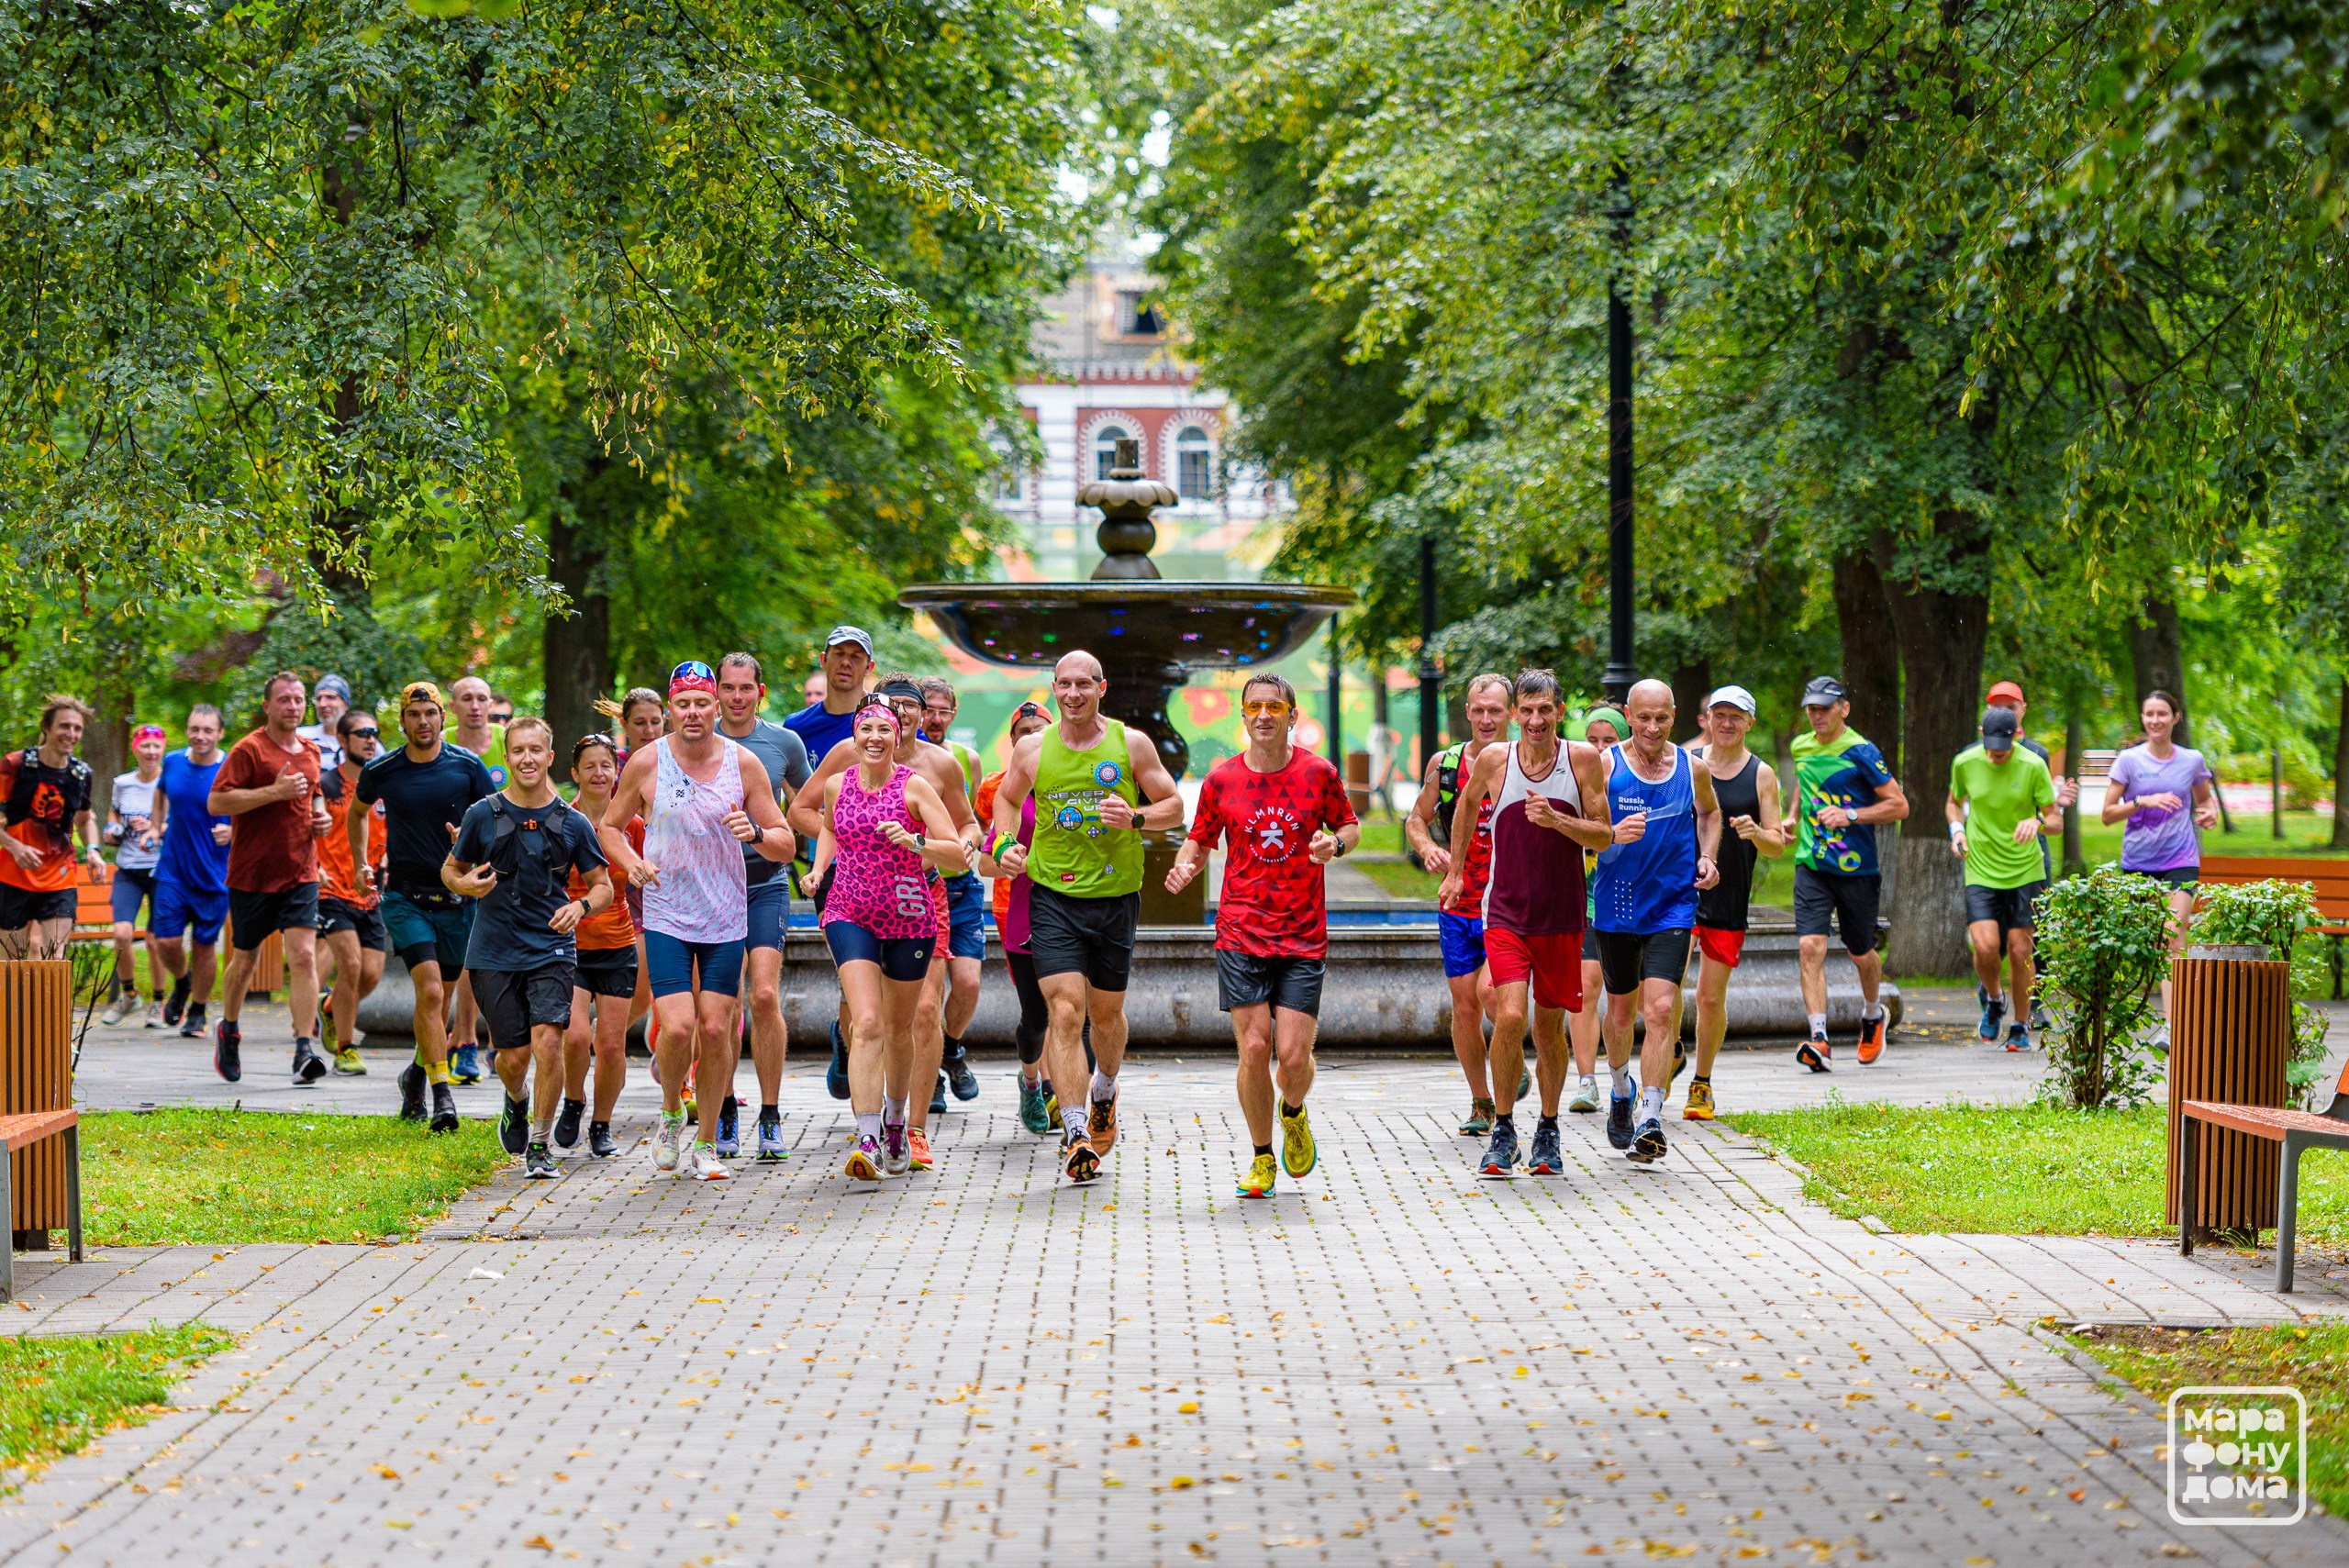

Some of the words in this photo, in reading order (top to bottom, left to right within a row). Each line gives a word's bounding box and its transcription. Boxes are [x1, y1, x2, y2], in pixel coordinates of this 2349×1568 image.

[1048, 790, 1105, 800] NEVER
[1618, 796, 1644, 805] Russia
[1619, 804, 1653, 813] Running
[1244, 806, 1299, 833] KLMNRUN
